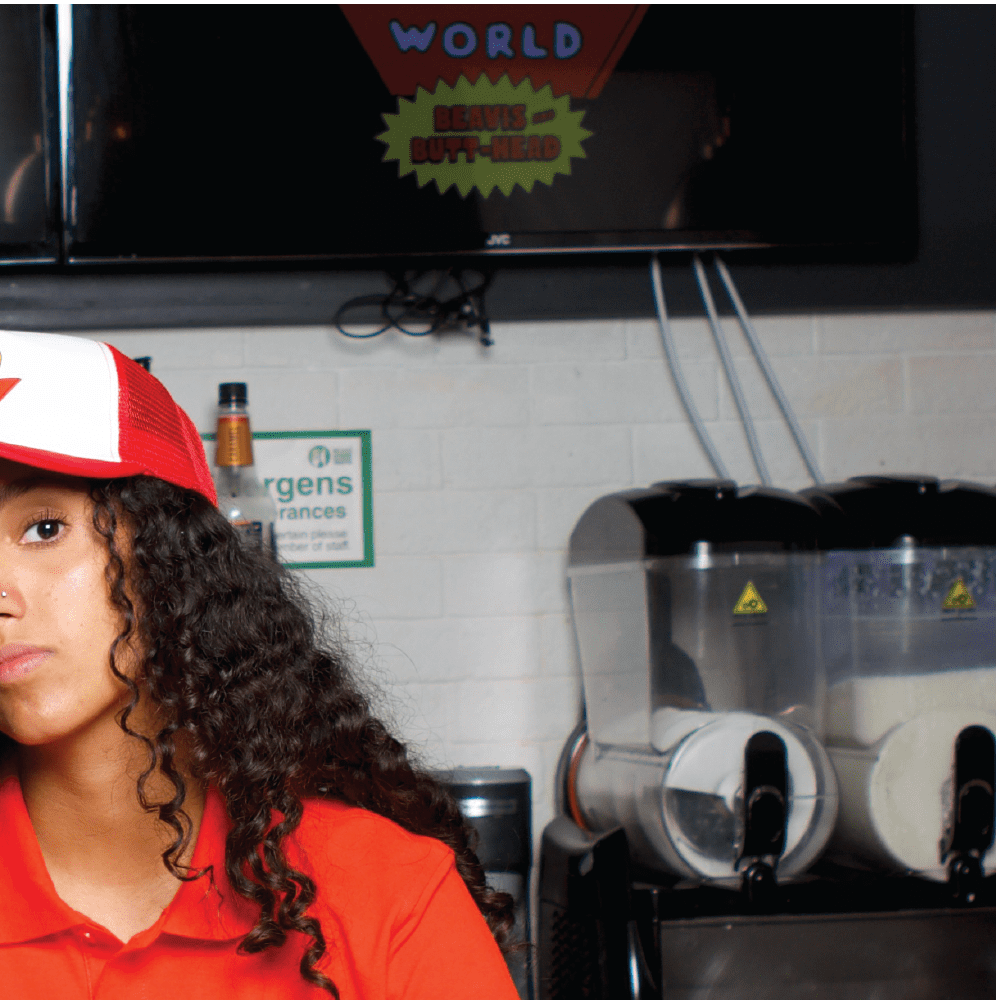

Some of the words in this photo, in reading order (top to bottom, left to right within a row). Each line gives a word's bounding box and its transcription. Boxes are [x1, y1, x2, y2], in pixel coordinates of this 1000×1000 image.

[389, 19, 583, 60] WORLD
[434, 104, 527, 132] BEAVIS
[411, 135, 561, 164] BUTT-HEAD
[486, 233, 510, 246] JVC
